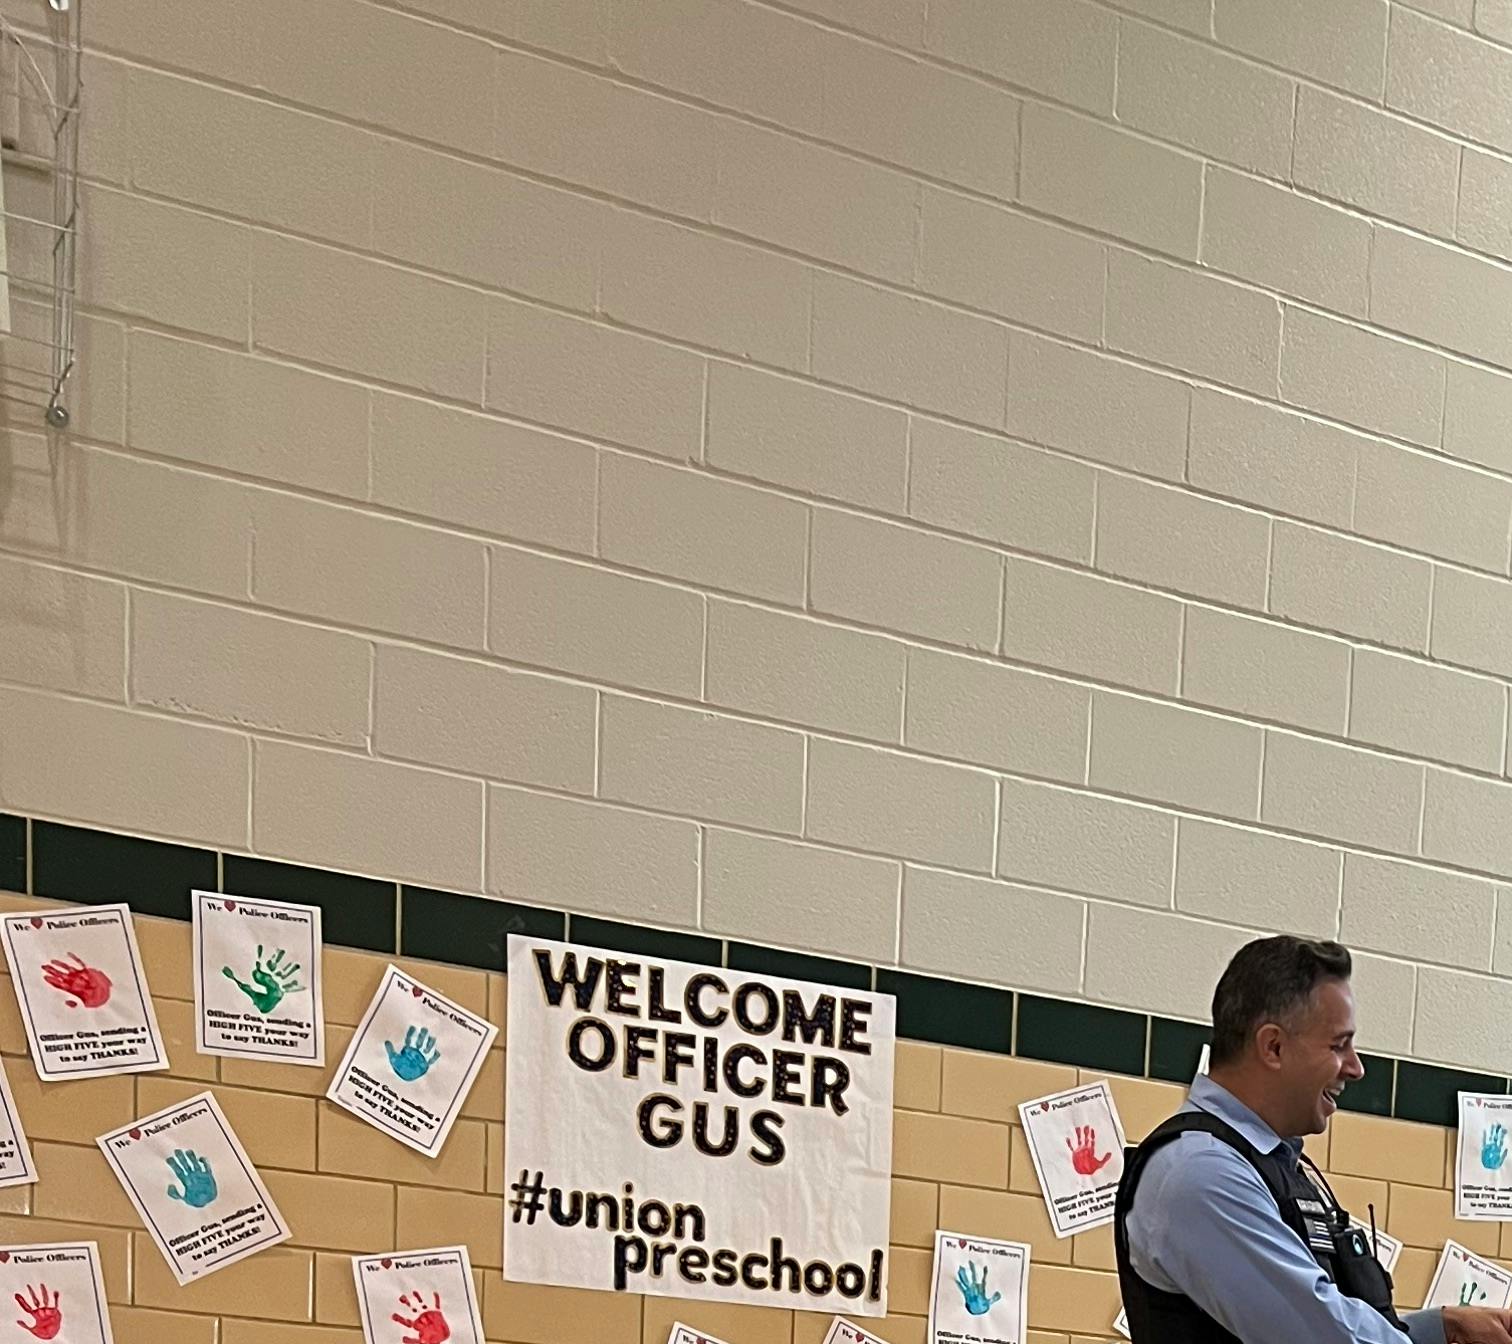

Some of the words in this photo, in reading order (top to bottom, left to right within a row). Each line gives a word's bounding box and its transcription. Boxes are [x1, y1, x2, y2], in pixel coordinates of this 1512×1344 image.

[46, 920, 78, 930] Police
[78, 917, 120, 927] Officers
[238, 906, 269, 918] Police
[270, 911, 309, 924] Officers
[422, 996, 448, 1016] Police
[532, 948, 873, 1056] WELCOME
[206, 1008, 241, 1020] Officer
[238, 1023, 262, 1034] FIVE
[39, 1034, 74, 1042] Officer
[251, 1035, 298, 1048] THANKS!
[89, 1047, 139, 1060] THANKS!
[567, 1015, 850, 1117] OFFICER
[379, 1105, 421, 1133] THANKS!
[143, 1122, 172, 1138] Police
[636, 1092, 787, 1166] GUS
[508, 1168, 706, 1242] #union
[217, 1226, 262, 1250] THANKS!
[13, 1254, 45, 1265] Police
[46, 1252, 87, 1263] Officers
[394, 1261, 422, 1270] Police
[613, 1234, 884, 1302] preschool
